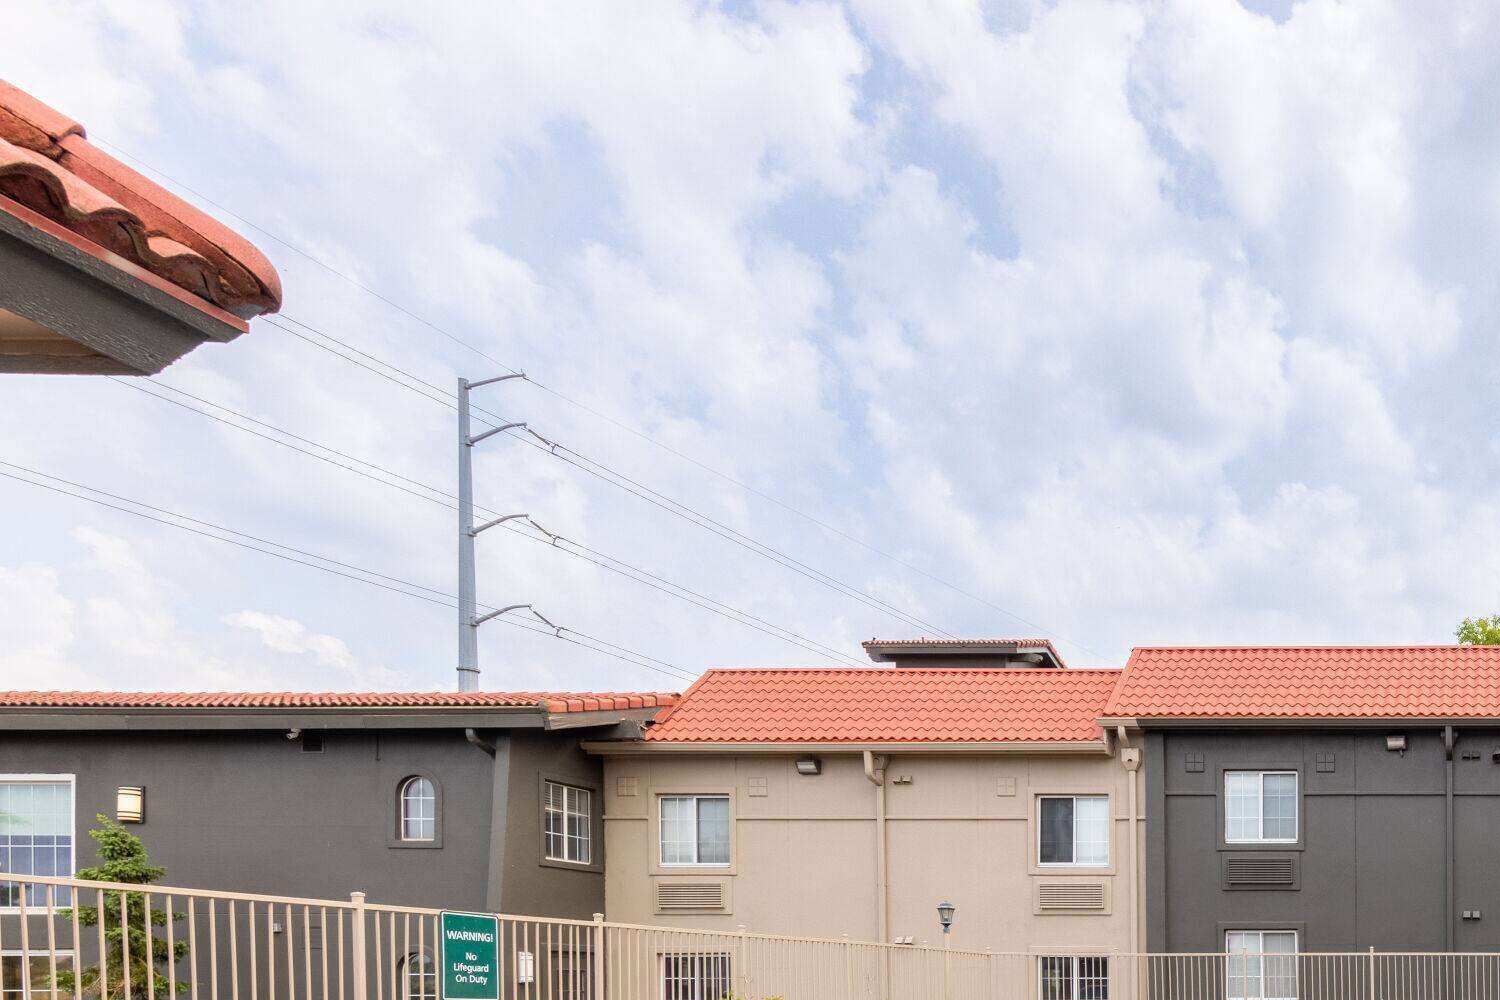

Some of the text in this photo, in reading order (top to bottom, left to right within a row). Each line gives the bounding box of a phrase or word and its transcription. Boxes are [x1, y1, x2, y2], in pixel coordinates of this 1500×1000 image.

[447, 930, 493, 942] WARNING!
[465, 952, 477, 961] No
[453, 963, 489, 973] Lifeguard
[455, 975, 488, 985] On Duty
